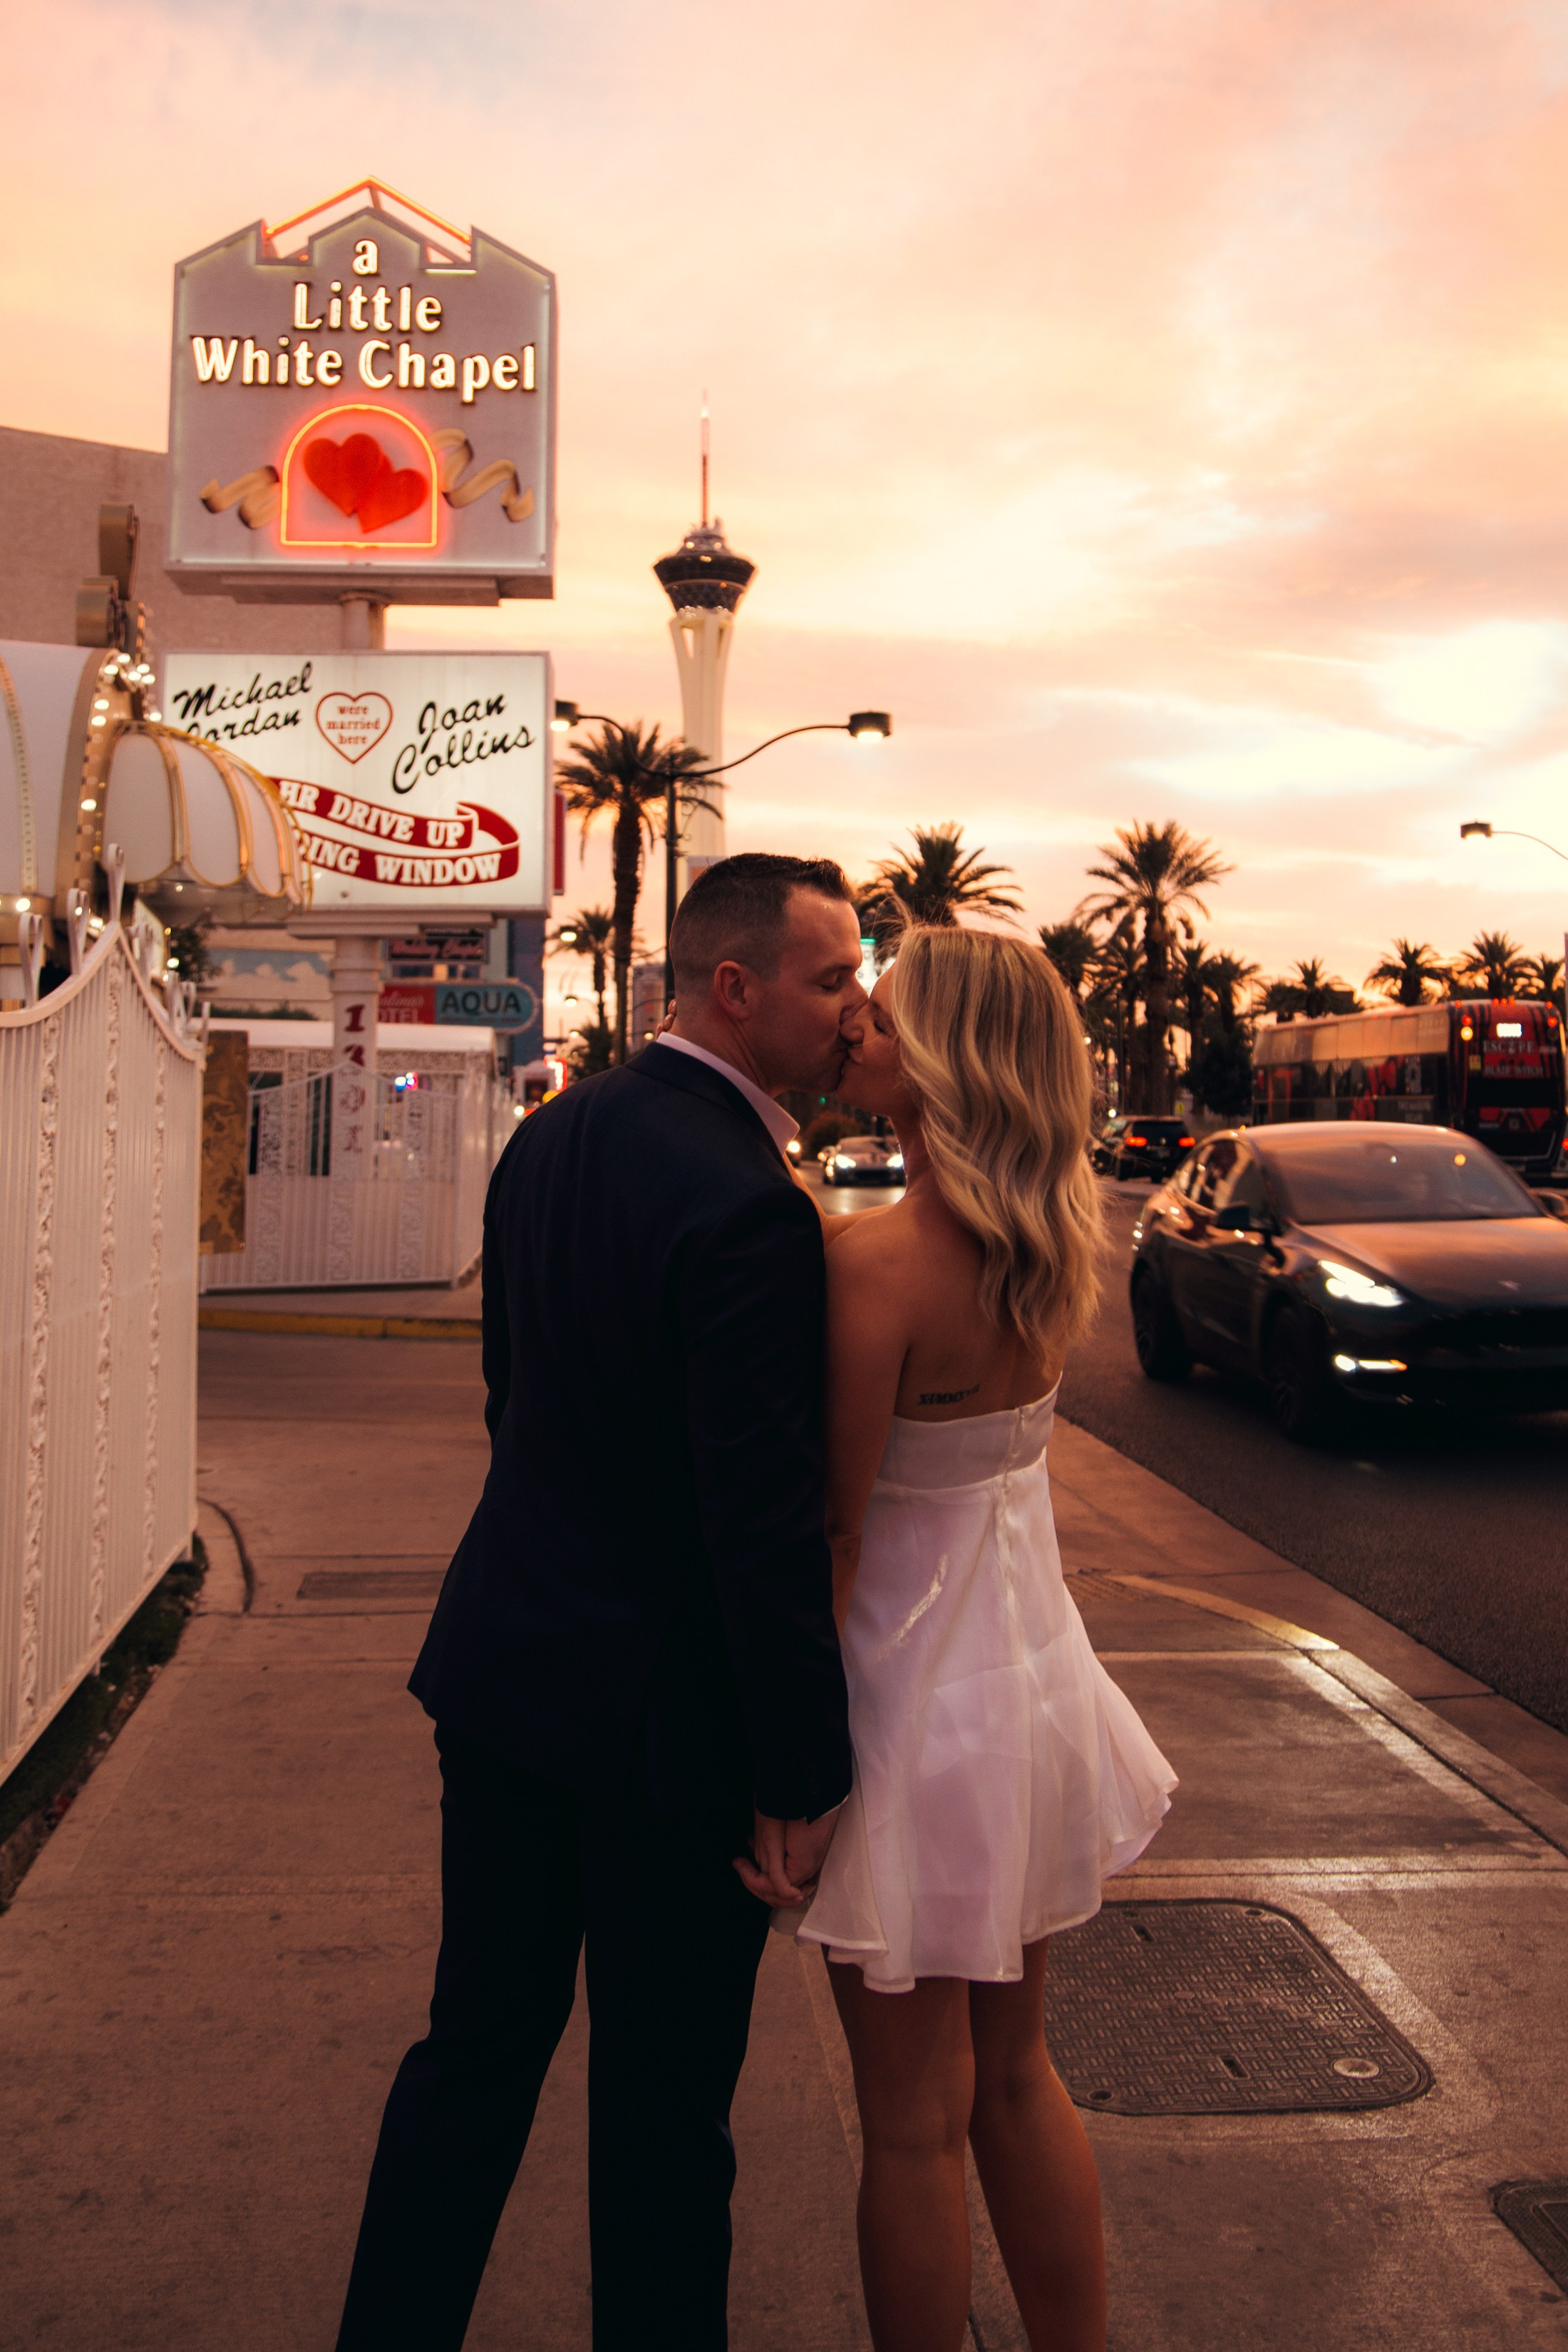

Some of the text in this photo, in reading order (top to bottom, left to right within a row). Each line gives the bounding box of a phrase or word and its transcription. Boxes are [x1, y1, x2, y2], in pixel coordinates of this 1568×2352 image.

[352, 239, 379, 276] a
[293, 280, 443, 332] Little
[190, 334, 537, 403] White Chapel
[172, 661, 314, 720] Michael
[337, 703, 368, 716] were
[326, 719, 381, 732] married
[338, 733, 368, 746] here
[418, 692, 507, 753] Joan
[392, 724, 536, 795] Collins
[327, 793, 416, 843] DRIVE
[426, 820, 465, 848] UP
[374, 853, 502, 885] WINDOW
[441, 991, 521, 1016] AQUA
